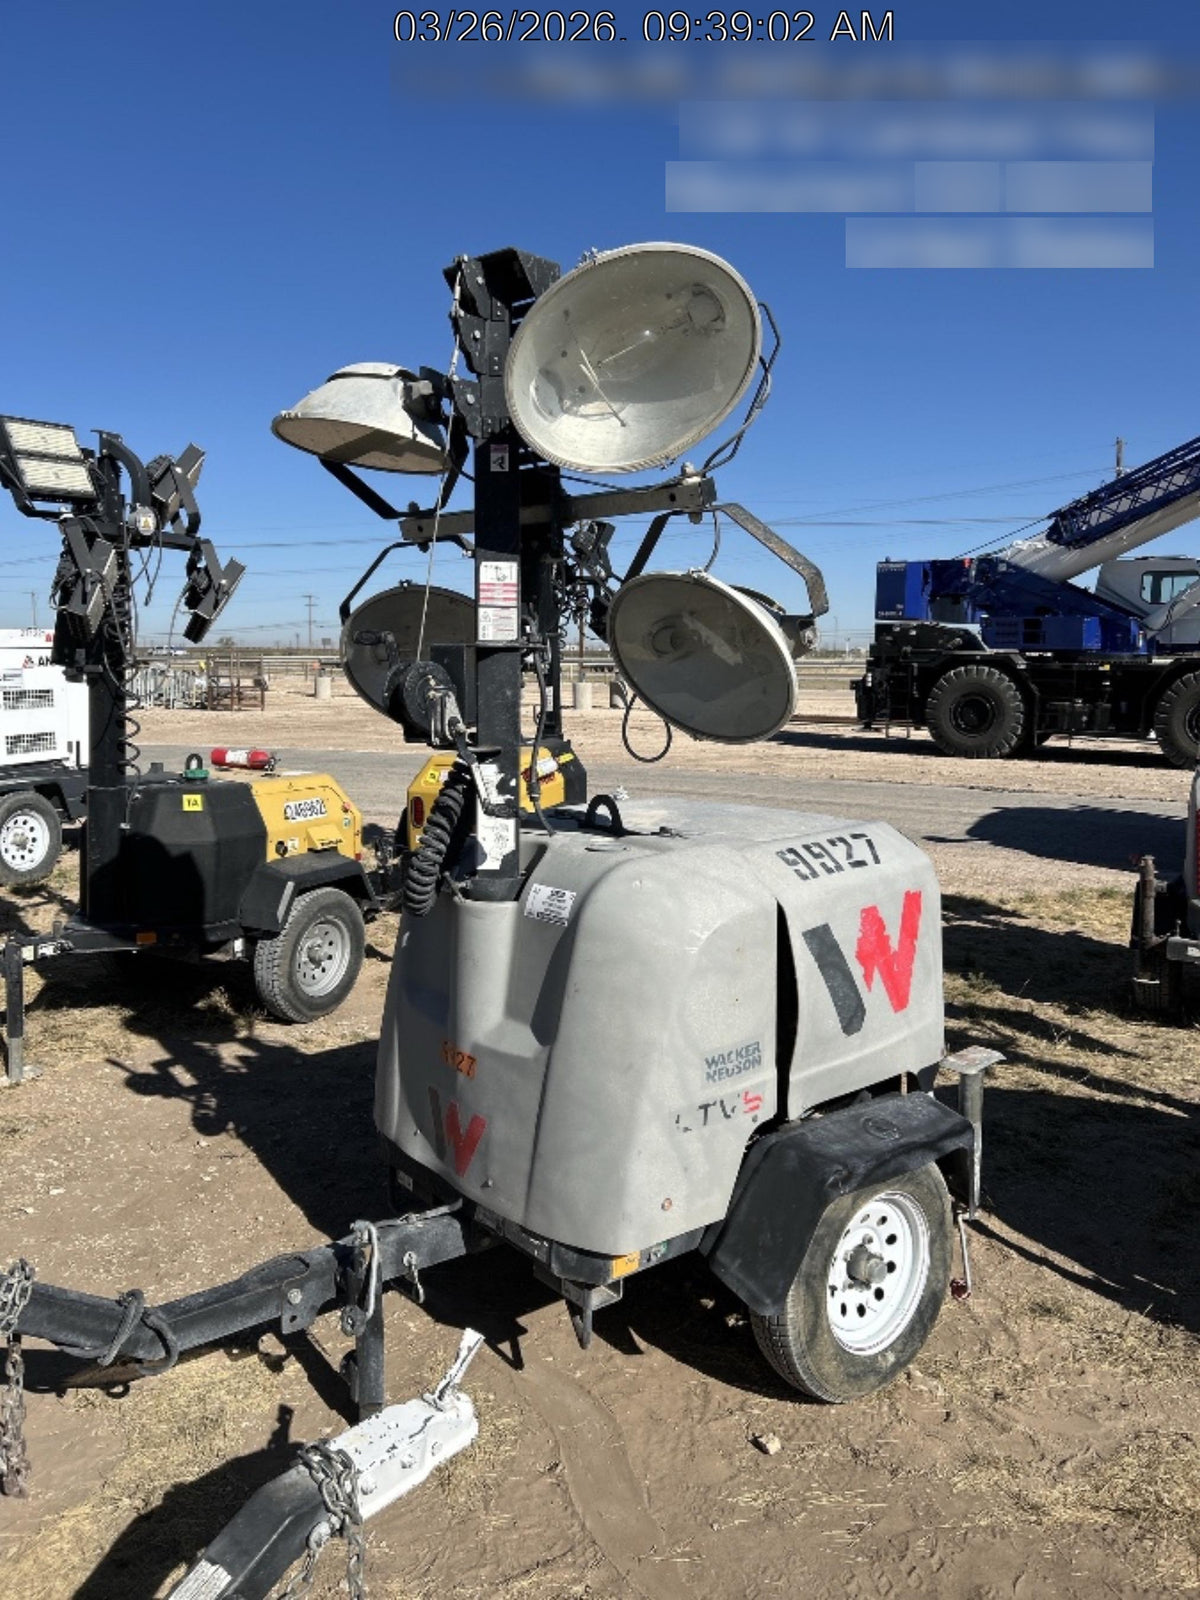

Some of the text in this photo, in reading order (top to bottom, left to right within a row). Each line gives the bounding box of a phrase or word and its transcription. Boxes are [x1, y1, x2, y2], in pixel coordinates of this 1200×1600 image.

[776, 833, 881, 881] 9927
[704, 1041, 761, 1070] WACKER
[706, 1054, 762, 1082] NEUSON
